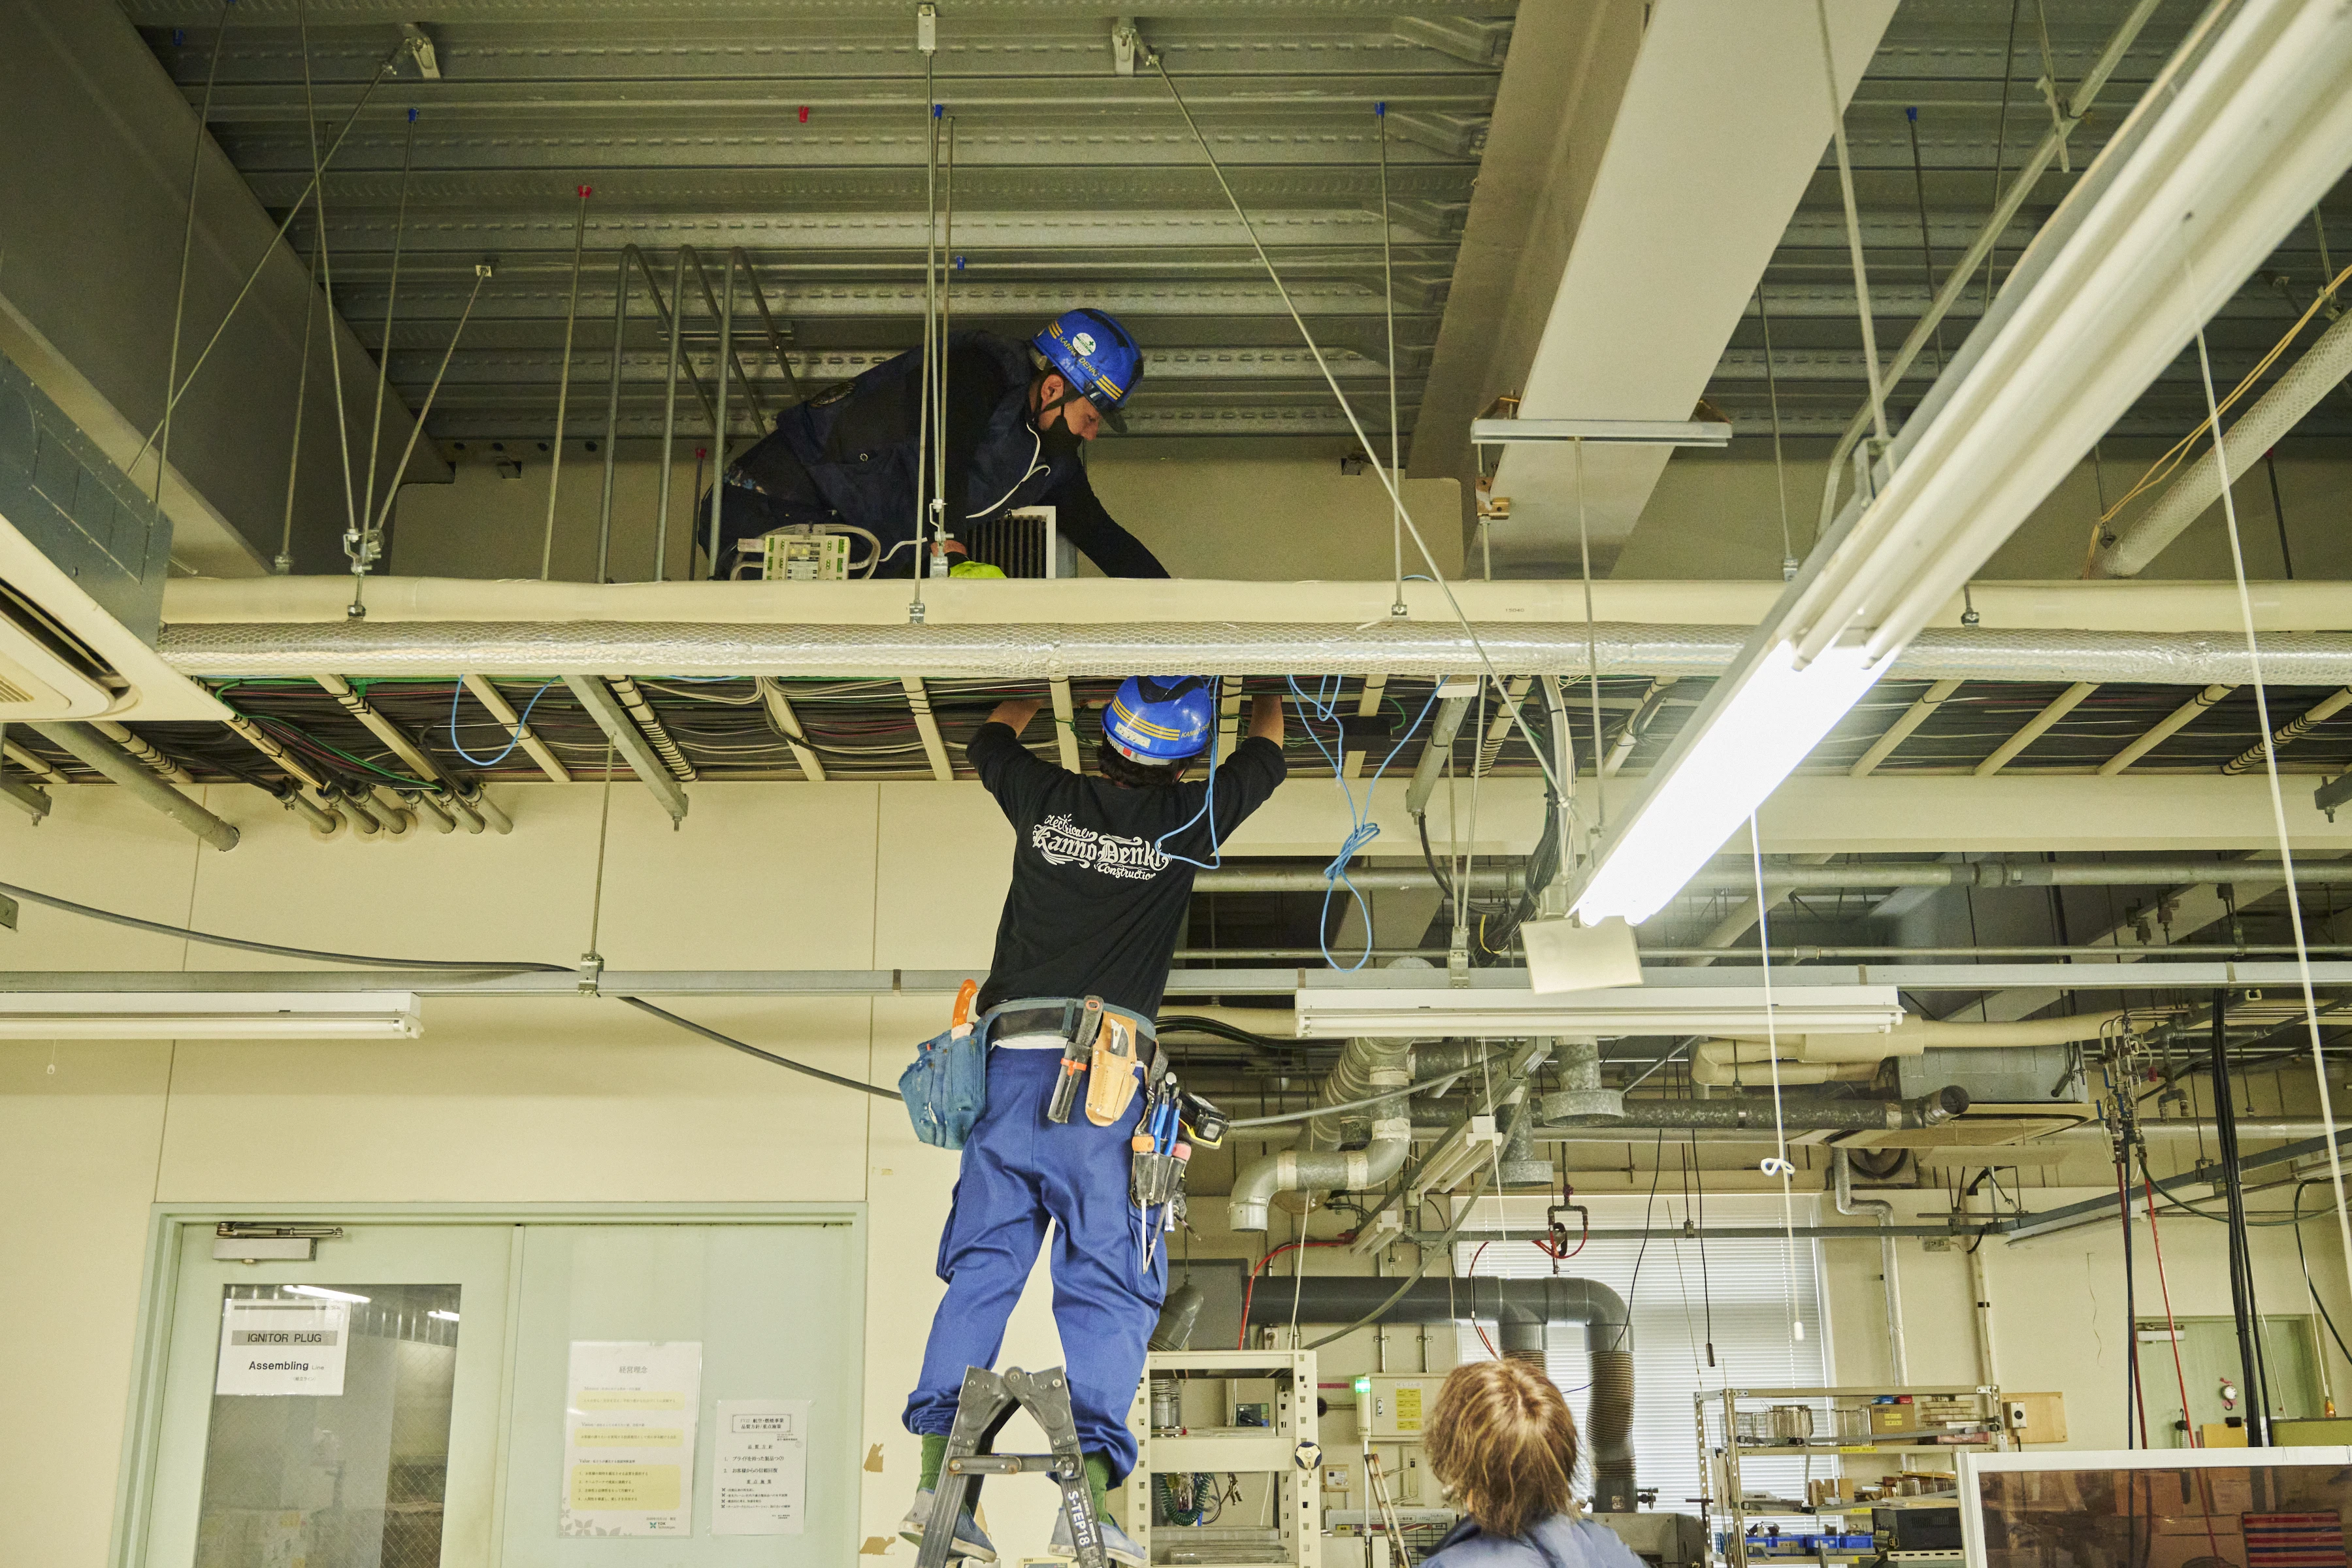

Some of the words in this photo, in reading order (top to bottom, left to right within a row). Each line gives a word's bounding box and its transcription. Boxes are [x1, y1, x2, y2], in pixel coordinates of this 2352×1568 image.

[1044, 814, 1090, 839] Electrical
[1032, 826, 1098, 864] Kanno
[248, 1333, 288, 1343] IGNITOR
[294, 1333, 321, 1342] PLUG
[249, 1361, 309, 1371] Assembling
[1068, 1490, 1090, 1546] S-TEP18
